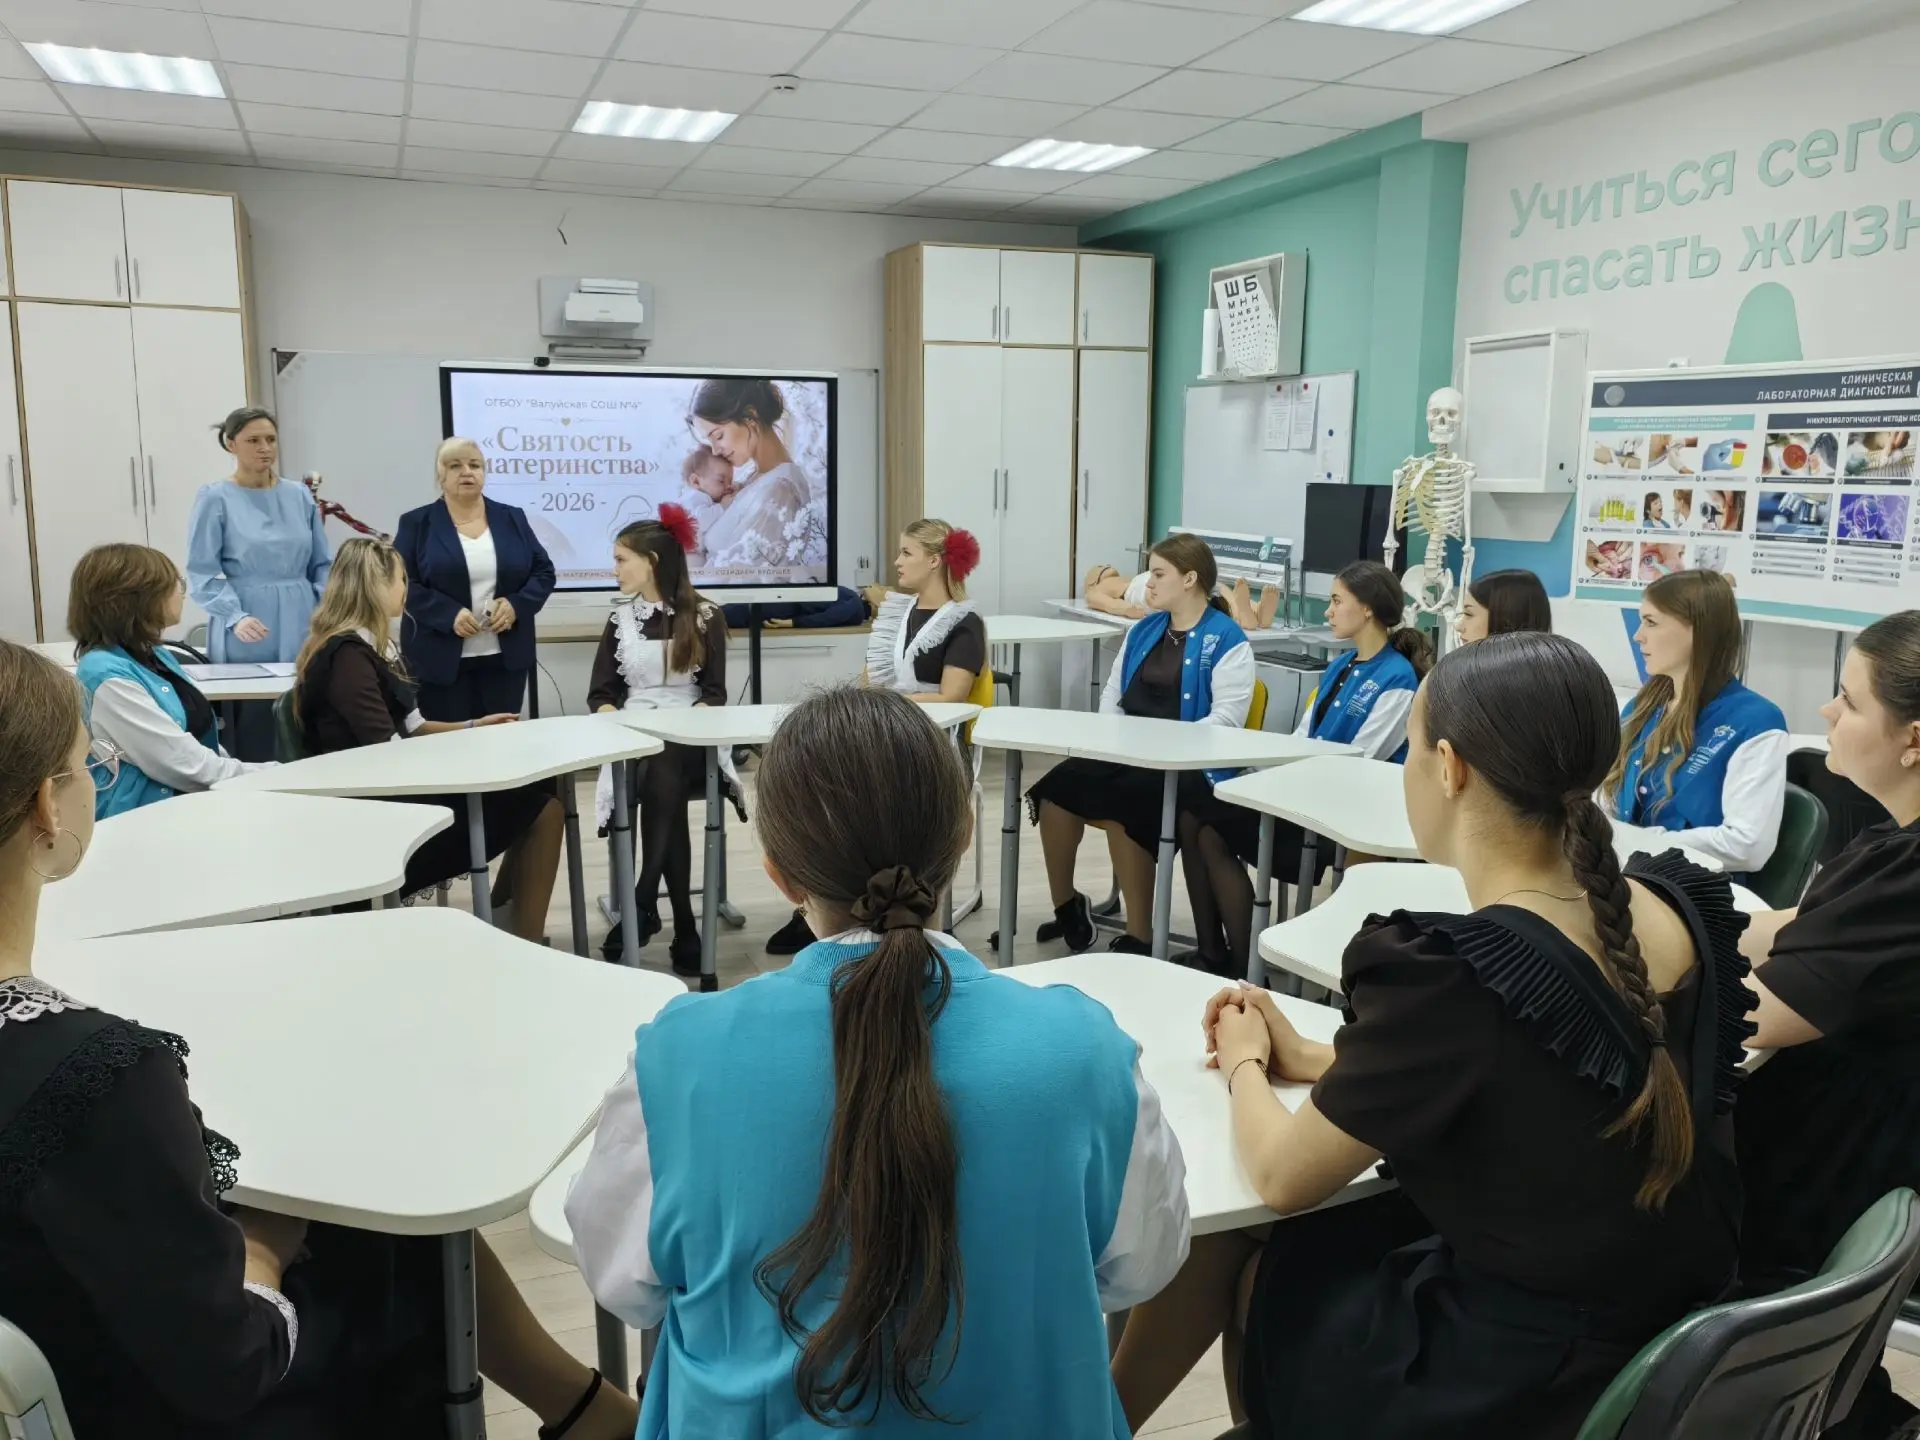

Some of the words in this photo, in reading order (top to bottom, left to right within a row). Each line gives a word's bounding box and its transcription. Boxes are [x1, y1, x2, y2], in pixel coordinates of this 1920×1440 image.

[1509, 150, 1737, 239] Учиться
[1757, 111, 1920, 188] сего
[1503, 235, 1720, 304] спасать
[1224, 279, 1240, 298] Ш
[1243, 274, 1258, 293] Б
[1841, 371, 1913, 385] КЛИНИЧЕСКАЯ
[1756, 388, 1837, 401] ЛАБОРАТОРНАЯ
[1839, 384, 1911, 399] ДИАГНОСТИКА
[484, 397, 523, 408] ОГБОУ
[590, 400, 617, 410] СОШ
[1806, 415, 1881, 425] МИКРОБИОЛОГИЧЕСКИЕ
[1882, 415, 1909, 423] МЕТОДЫ
[482, 426, 633, 452] «Святость
[542, 492, 595, 512] 2026
